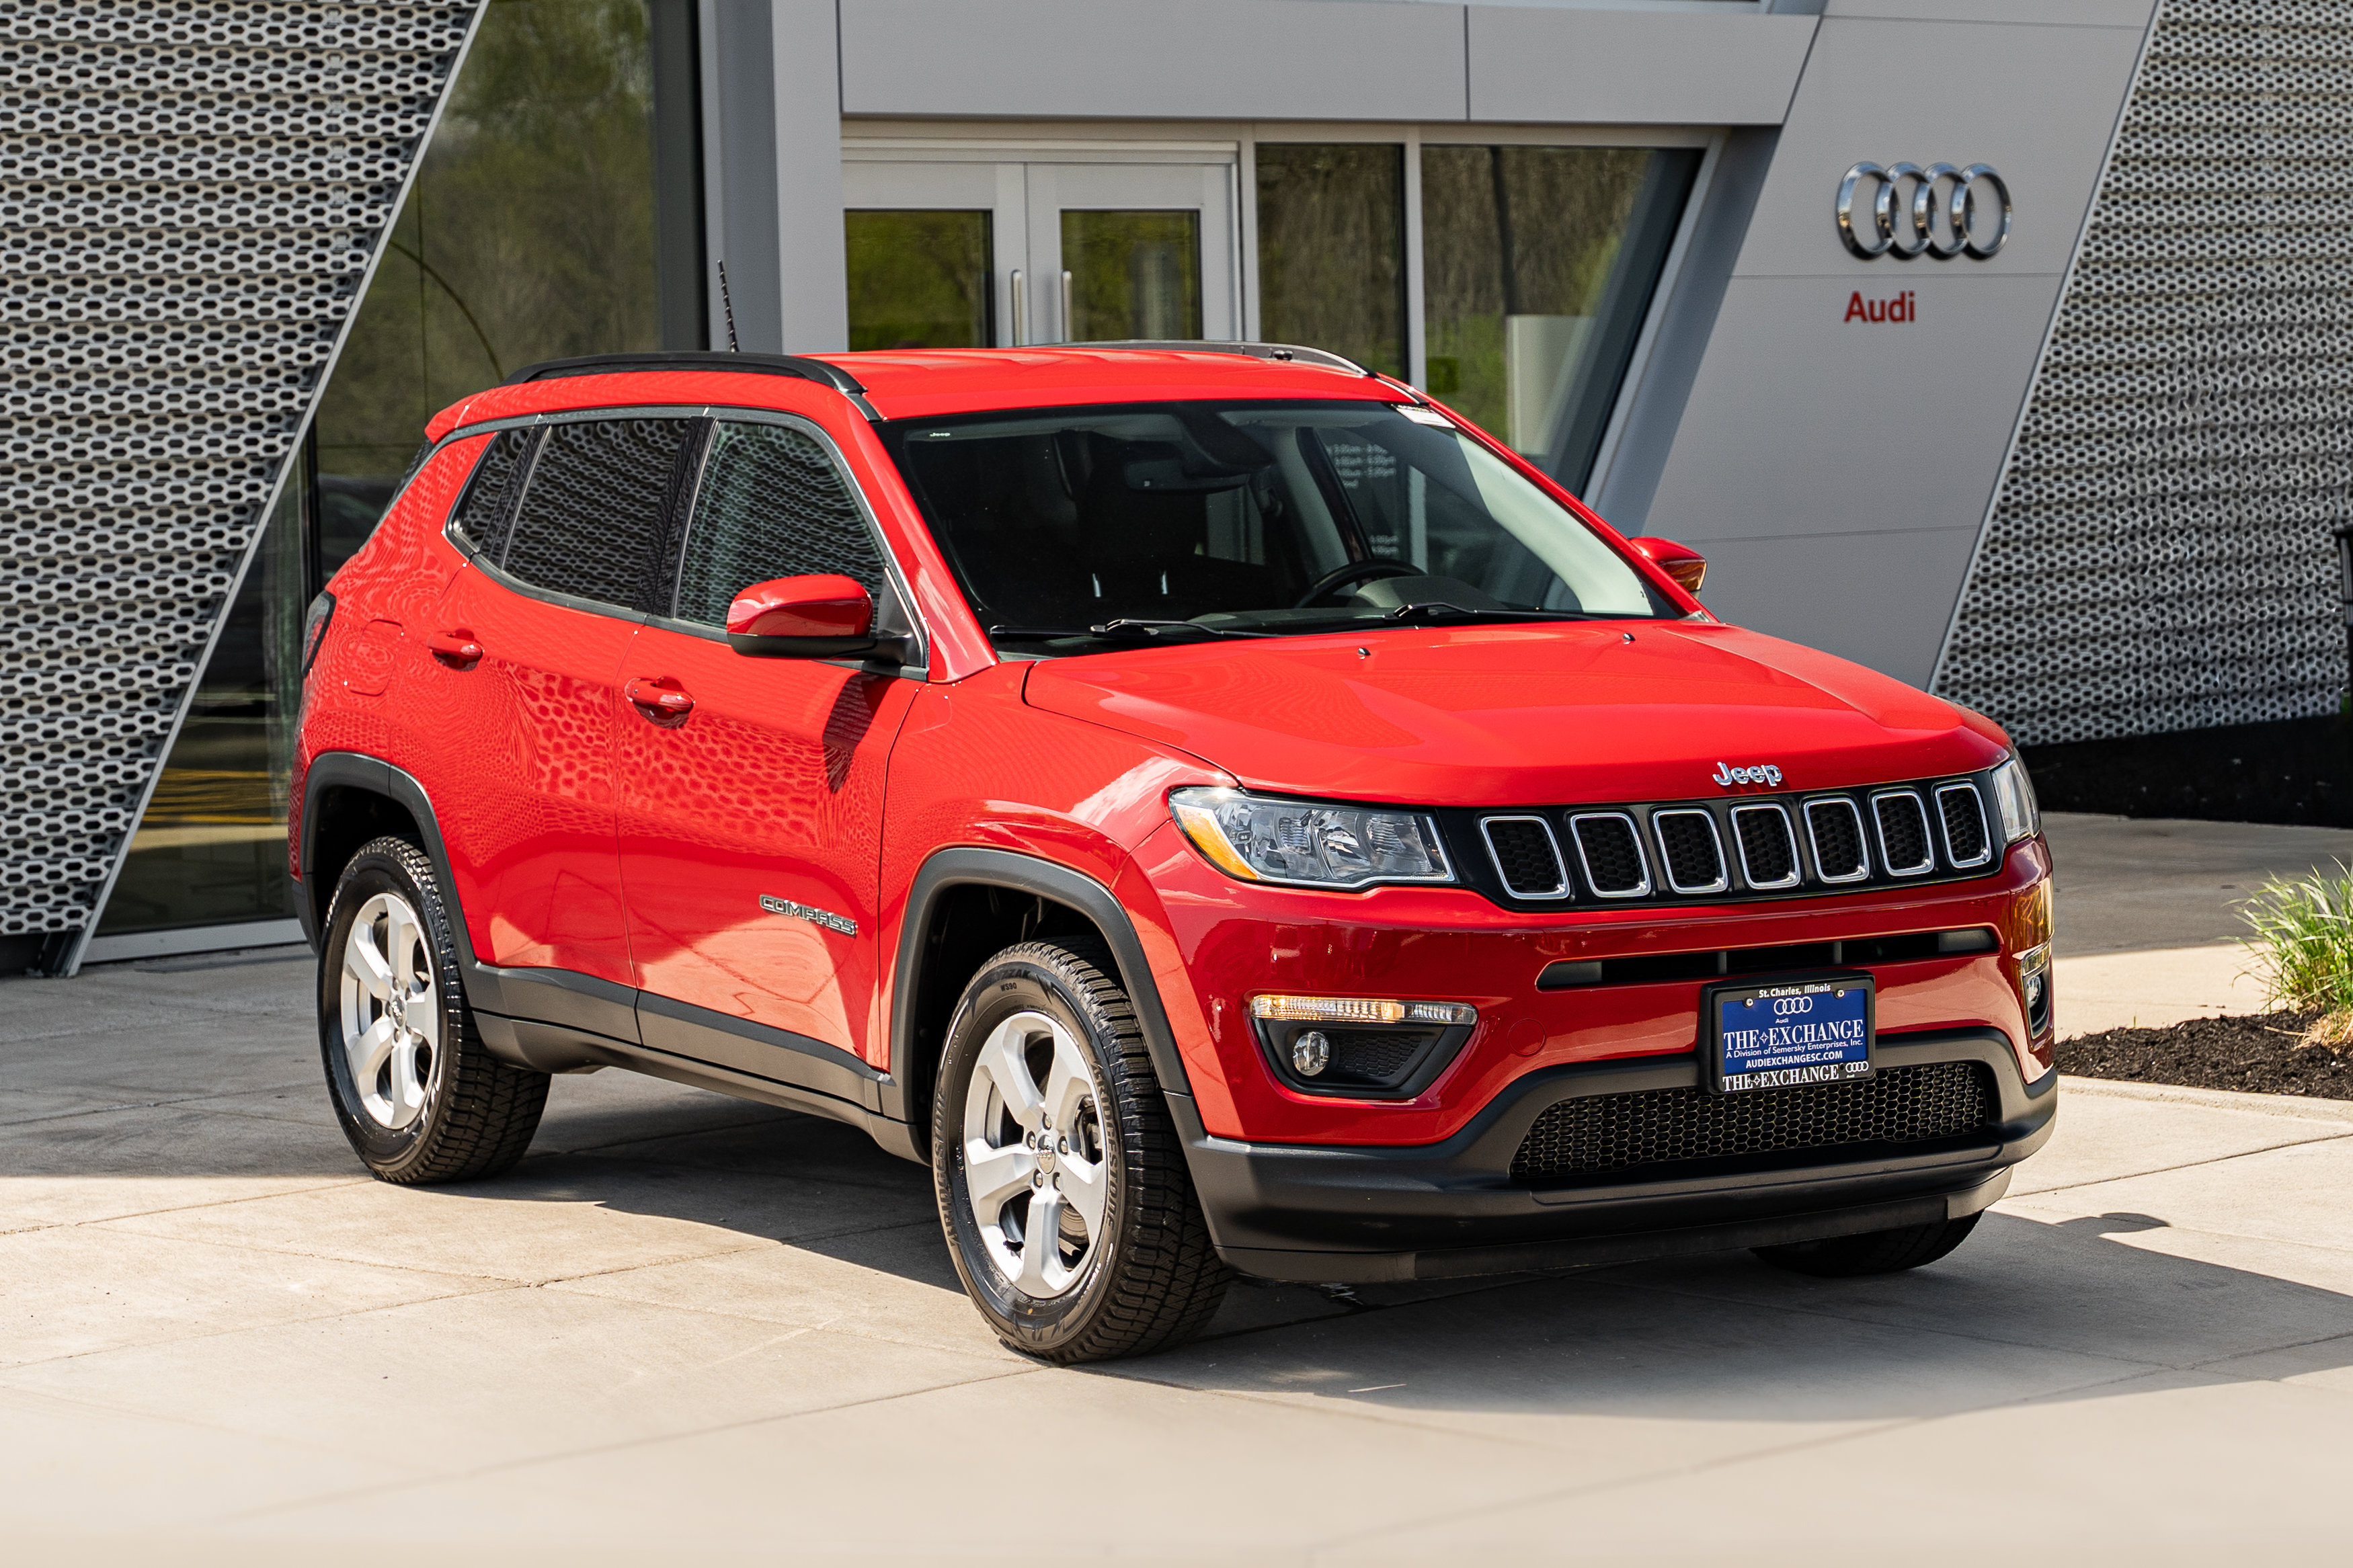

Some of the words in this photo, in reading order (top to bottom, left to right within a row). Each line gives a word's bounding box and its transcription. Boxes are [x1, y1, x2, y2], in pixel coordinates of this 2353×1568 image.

[1844, 290, 1915, 323] Audi
[1712, 761, 1782, 786] Jeep
[760, 895, 856, 935] COMPASS
[1000, 982, 1017, 991] WS90
[1759, 989, 1769, 998] St.
[1770, 987, 1802, 997] Charles,
[1804, 983, 1831, 993] Illinois
[1723, 1030, 1759, 1050] THE
[1768, 1019, 1864, 1046] EXCHANGE
[1734, 1048, 1761, 1058] Division
[1763, 1046, 1771, 1055] of
[1772, 1044, 1806, 1054] Semersky
[1808, 1041, 1849, 1051] Enterprises,
[1745, 1050, 1843, 1069] AUDIEXCHANGESC.COM
[1722, 1074, 1755, 1092] THE
[1759, 1064, 1839, 1088] EXCHANGE
[1090, 1061, 1119, 1231] BRIDGESTONE
[934, 1091, 959, 1247] BRIDGESTONE
